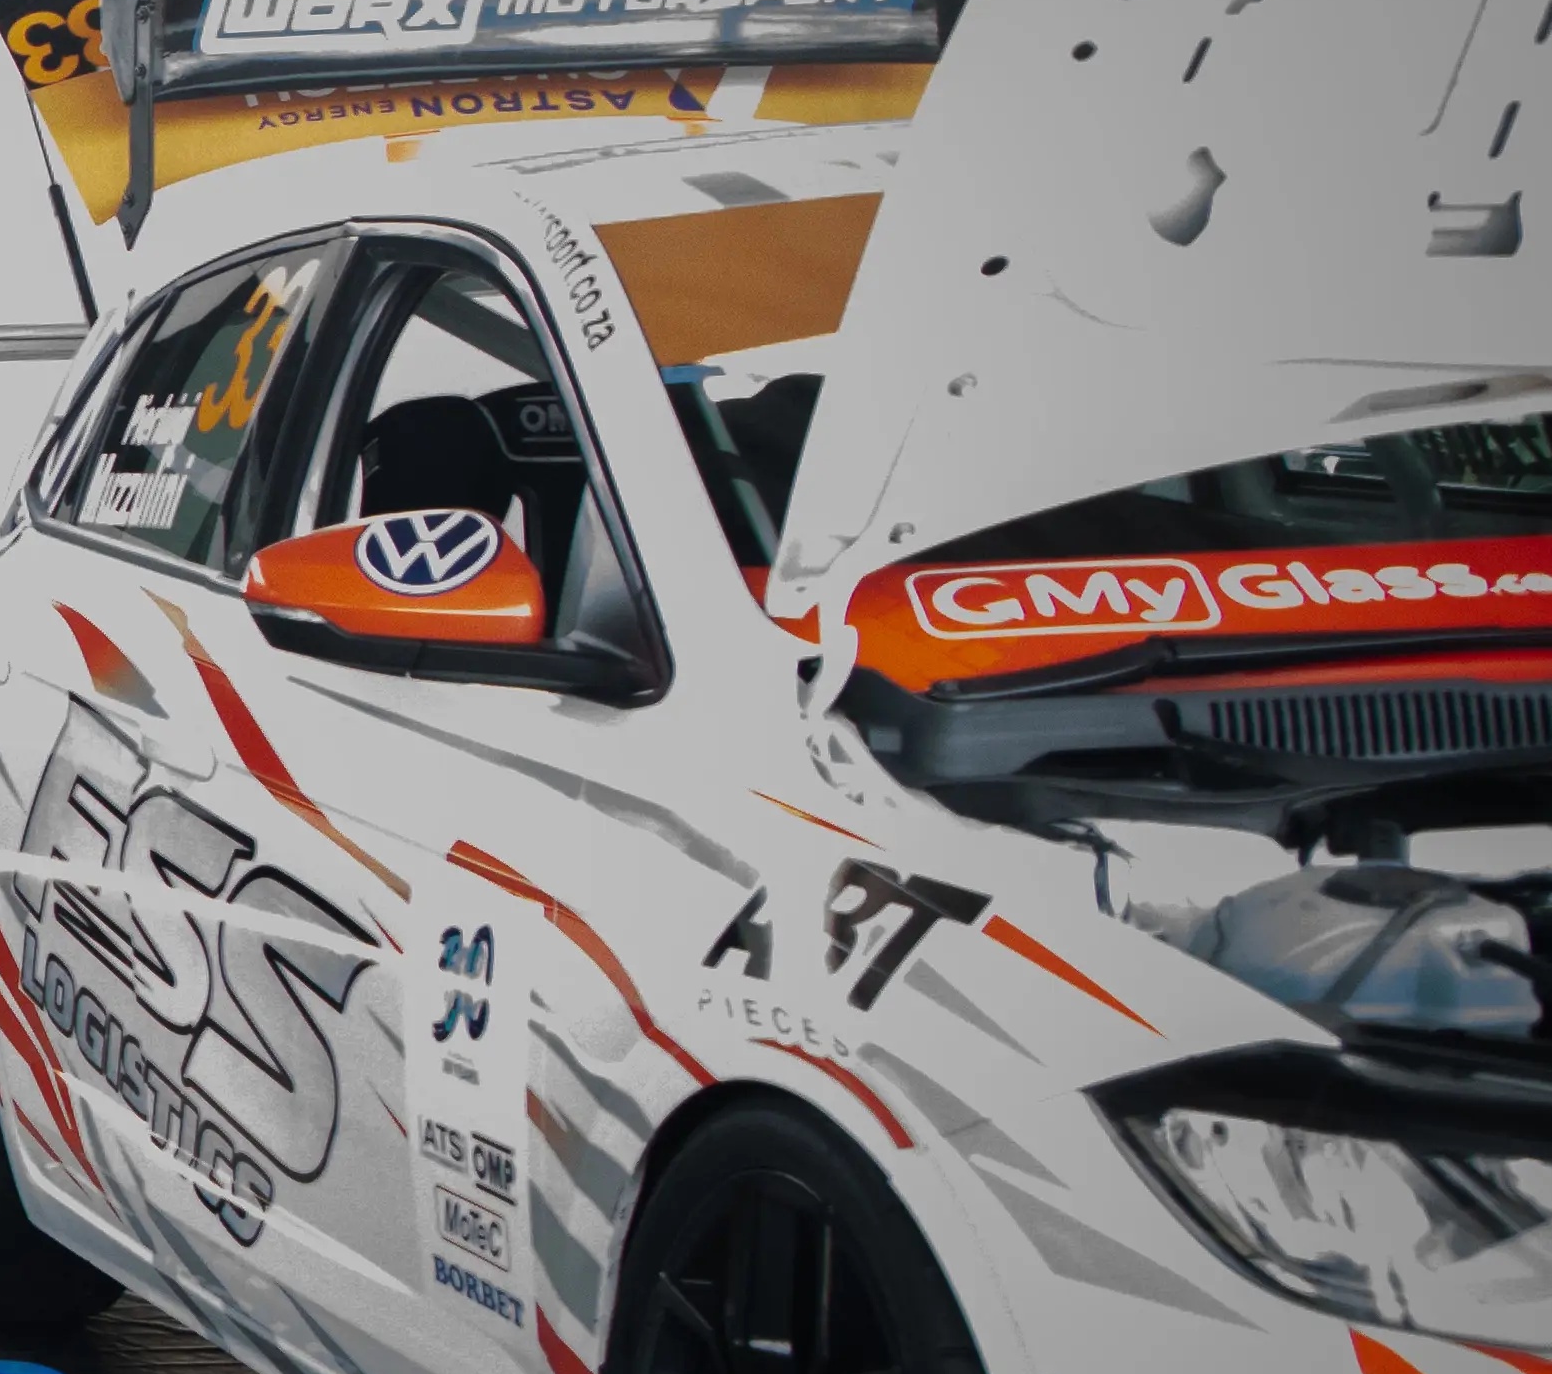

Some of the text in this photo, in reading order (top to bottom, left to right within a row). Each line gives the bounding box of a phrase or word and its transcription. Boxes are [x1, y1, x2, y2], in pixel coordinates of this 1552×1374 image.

[258, 88, 635, 130] ASTRON ENERGY
[519, 404, 568, 433] OM
[20, 924, 275, 1248] LOGISTICS
[423, 1118, 517, 1194] ATS OMP
[432, 1252, 525, 1329] BORBET
